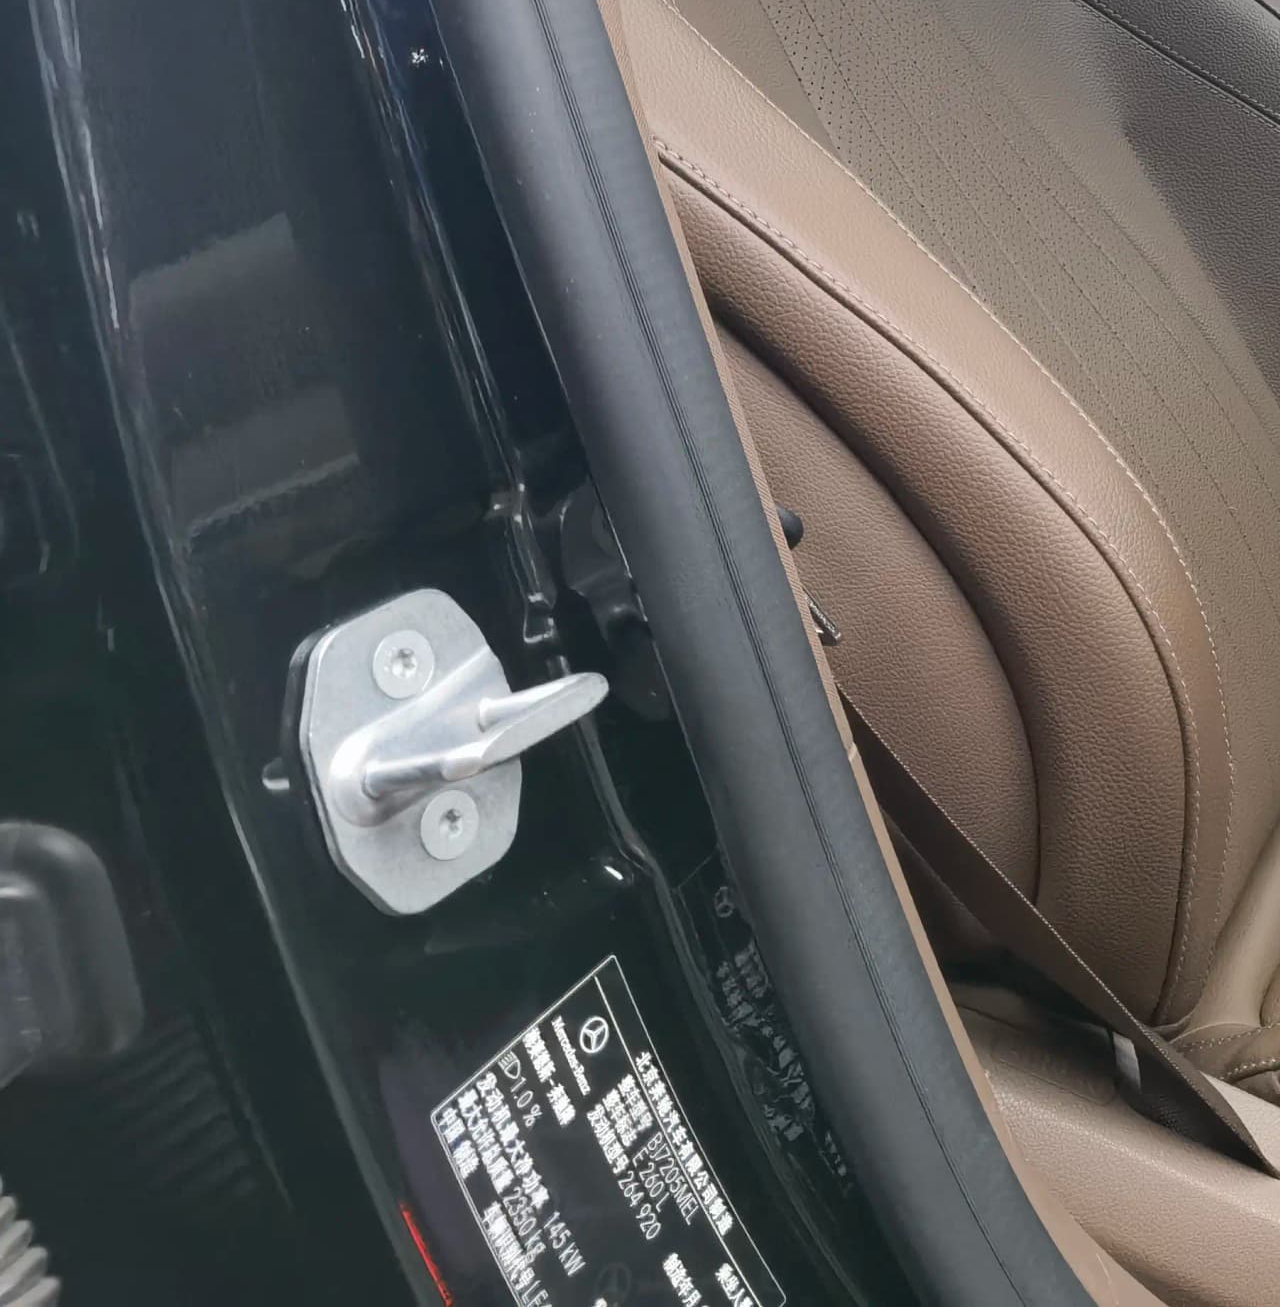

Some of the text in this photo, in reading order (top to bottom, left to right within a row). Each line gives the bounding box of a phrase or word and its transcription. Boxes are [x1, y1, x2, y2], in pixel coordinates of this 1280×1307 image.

[511, 1076, 543, 1127] 1.0 %
[632, 1146, 649, 1167] E
[635, 1051, 733, 1236] 北京奔驰汽车有限公司制造
[587, 1102, 661, 1240] 发动机型号 264 920
[639, 1162, 665, 1199] 260
[648, 1132, 699, 1225] BJ7205MEL
[503, 1187, 537, 1237] 2350
[655, 1192, 670, 1213] L
[544, 1211, 572, 1249] 145
[558, 1242, 586, 1277] kW
